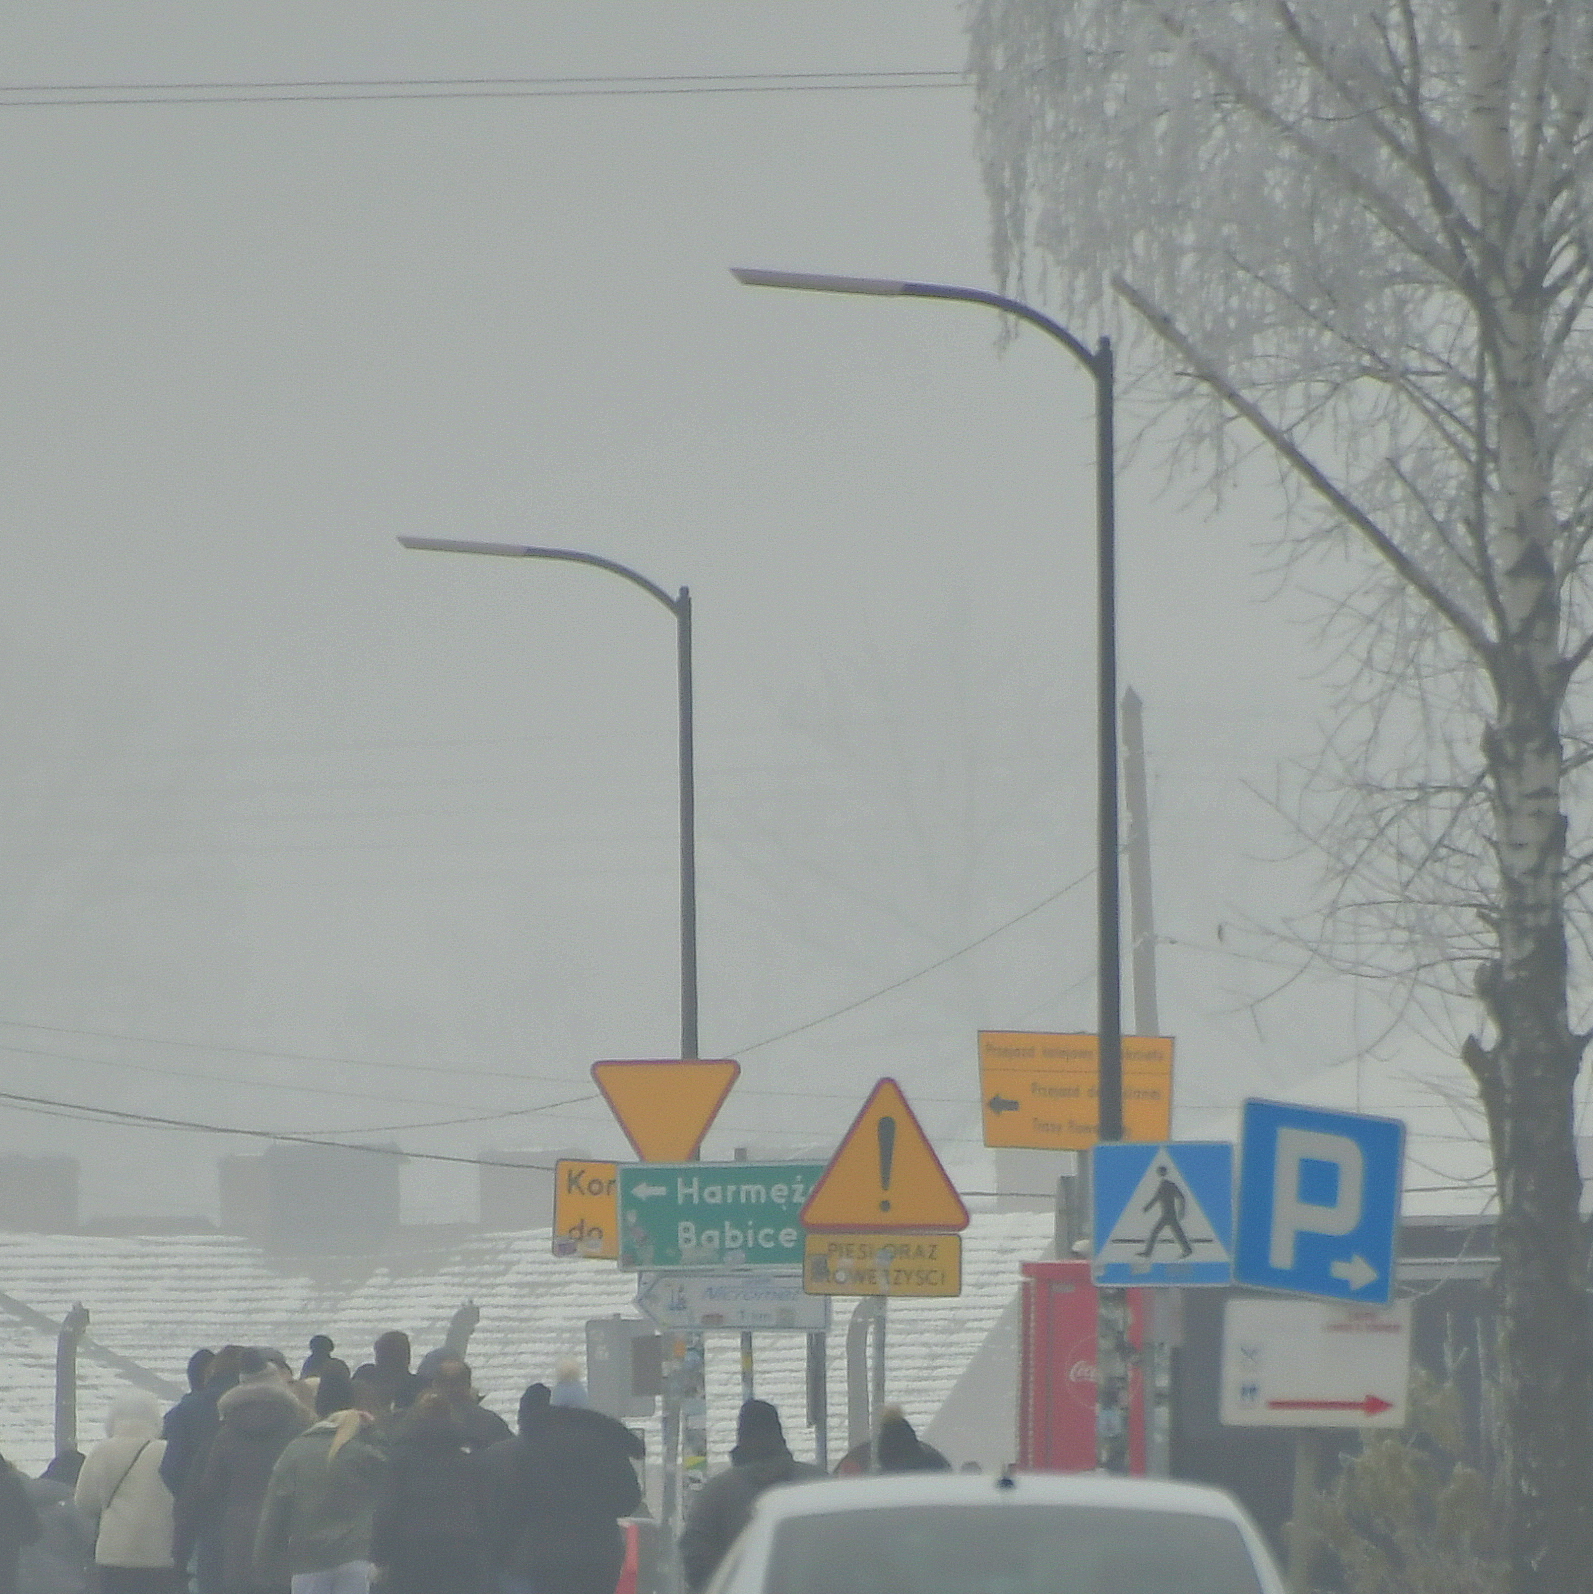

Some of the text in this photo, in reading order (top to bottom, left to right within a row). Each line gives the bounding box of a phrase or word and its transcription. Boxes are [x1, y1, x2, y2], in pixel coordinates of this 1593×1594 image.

[677, 1174, 813, 1211] Harmęż
[1269, 1126, 1364, 1271] P
[677, 1220, 798, 1249] Babice
[827, 1242, 874, 1261] PIESI
